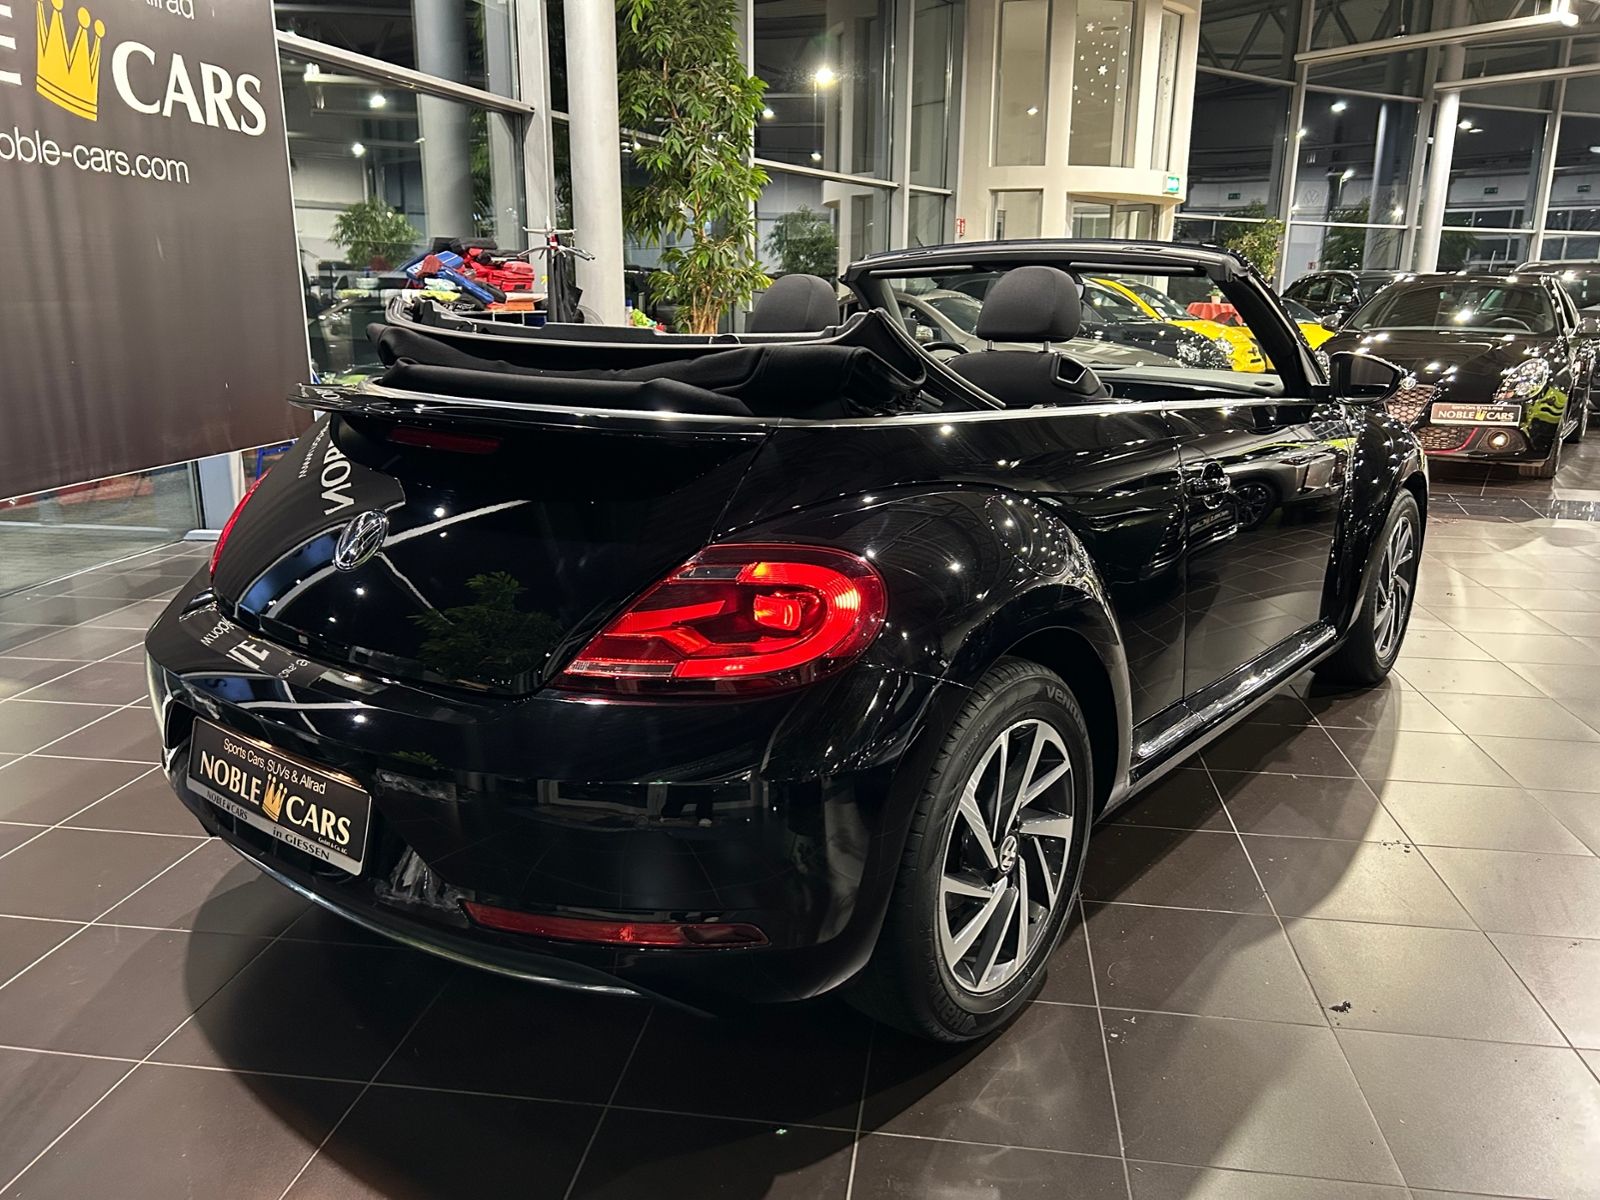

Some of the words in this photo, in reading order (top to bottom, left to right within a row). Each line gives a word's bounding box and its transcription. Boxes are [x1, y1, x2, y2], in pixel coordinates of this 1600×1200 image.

[112, 41, 266, 137] CARS
[1438, 410, 1476, 420] NOBLE
[1486, 411, 1514, 420] CARS
[223, 738, 247, 760] Sports
[247, 750, 266, 771] Cars,
[266, 759, 290, 780] SUVs
[290, 770, 298, 784] &
[299, 774, 327, 795] Allrad
[200, 750, 262, 805] NOBLE
[285, 796, 351, 845] CARS
[206, 790, 228, 809] NOBLE
[231, 807, 248, 820] CARS
[272, 826, 283, 838] in
[285, 833, 330, 860] GIESSEN
